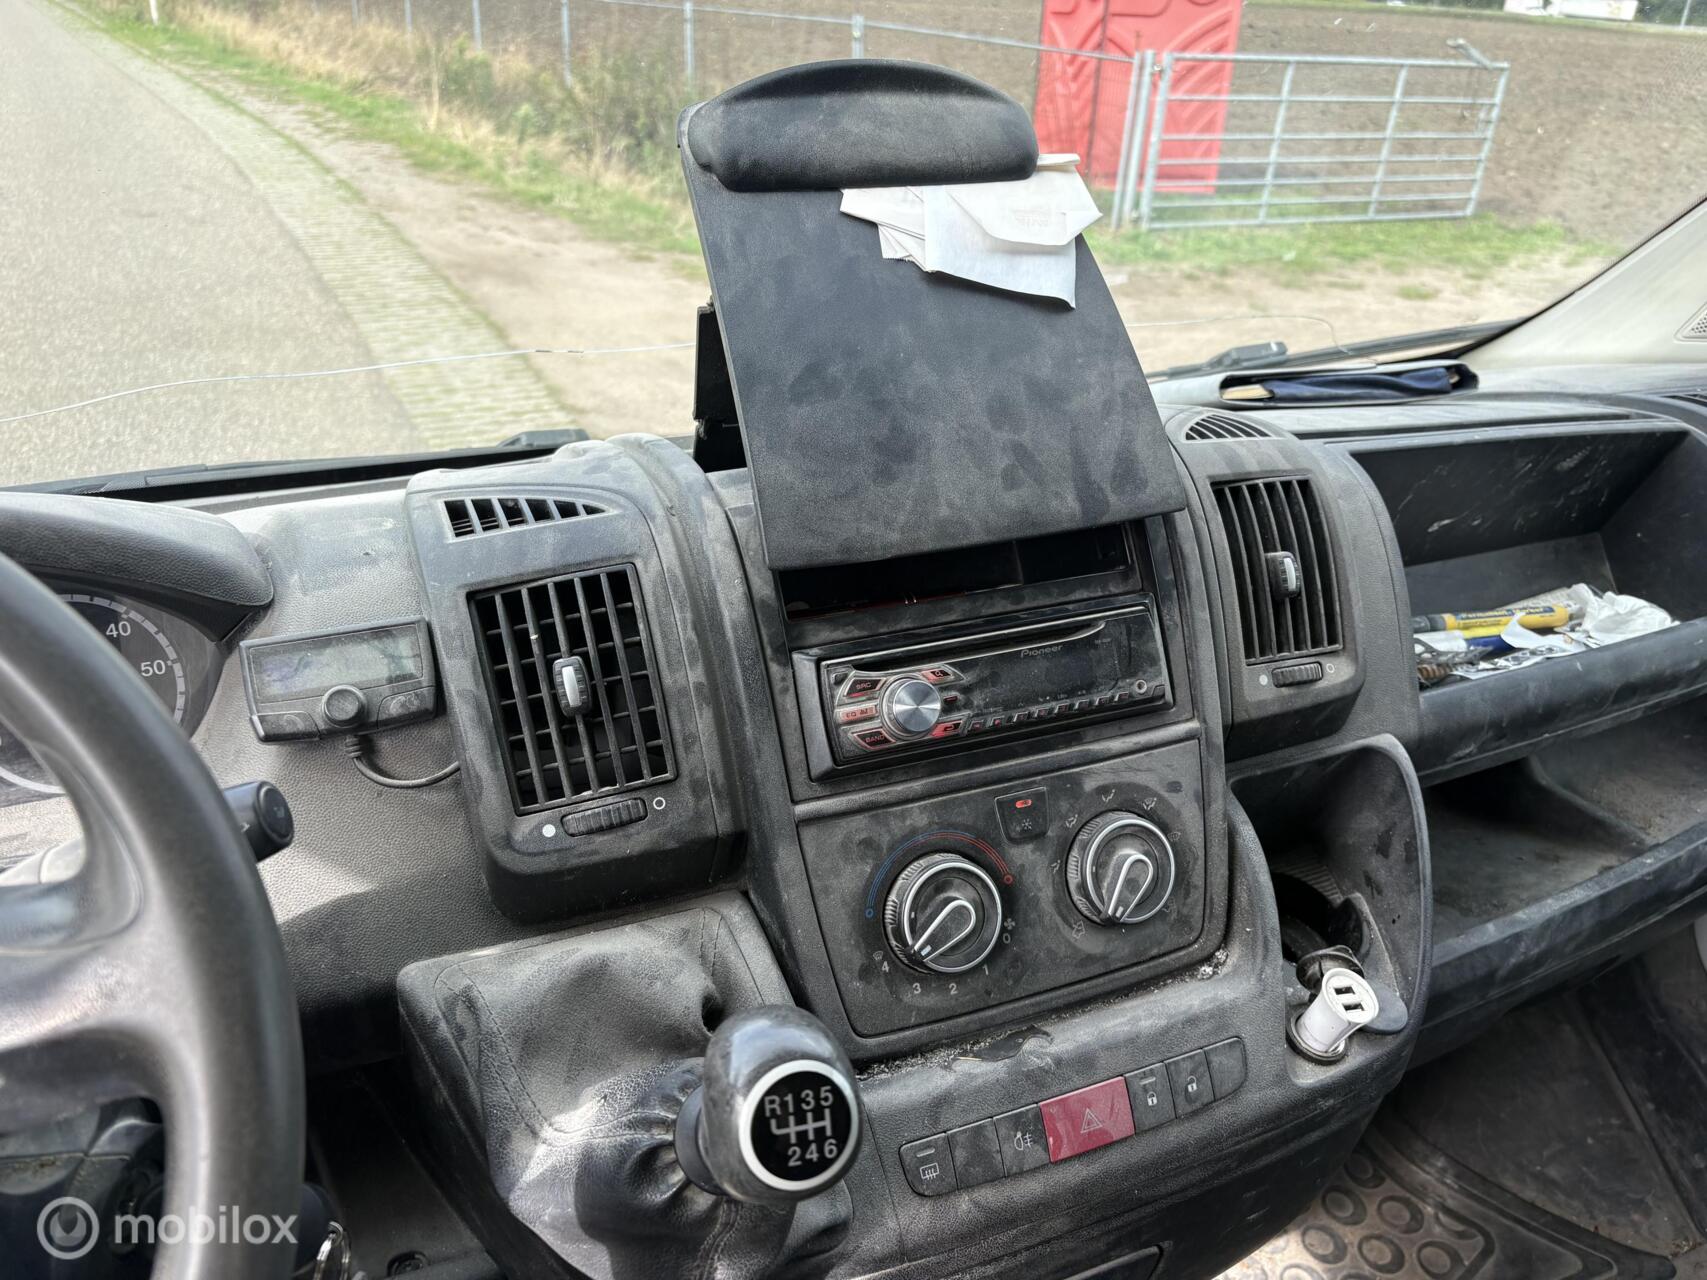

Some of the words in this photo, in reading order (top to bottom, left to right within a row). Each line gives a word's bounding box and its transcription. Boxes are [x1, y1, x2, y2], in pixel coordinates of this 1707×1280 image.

[106, 621, 131, 638] 40
[1021, 645, 1063, 658] Pioneer
[141, 660, 166, 677] 50
[881, 961, 890, 973] 4
[982, 964, 989, 976] 1
[912, 982, 921, 994] 3
[948, 983, 958, 995] 2
